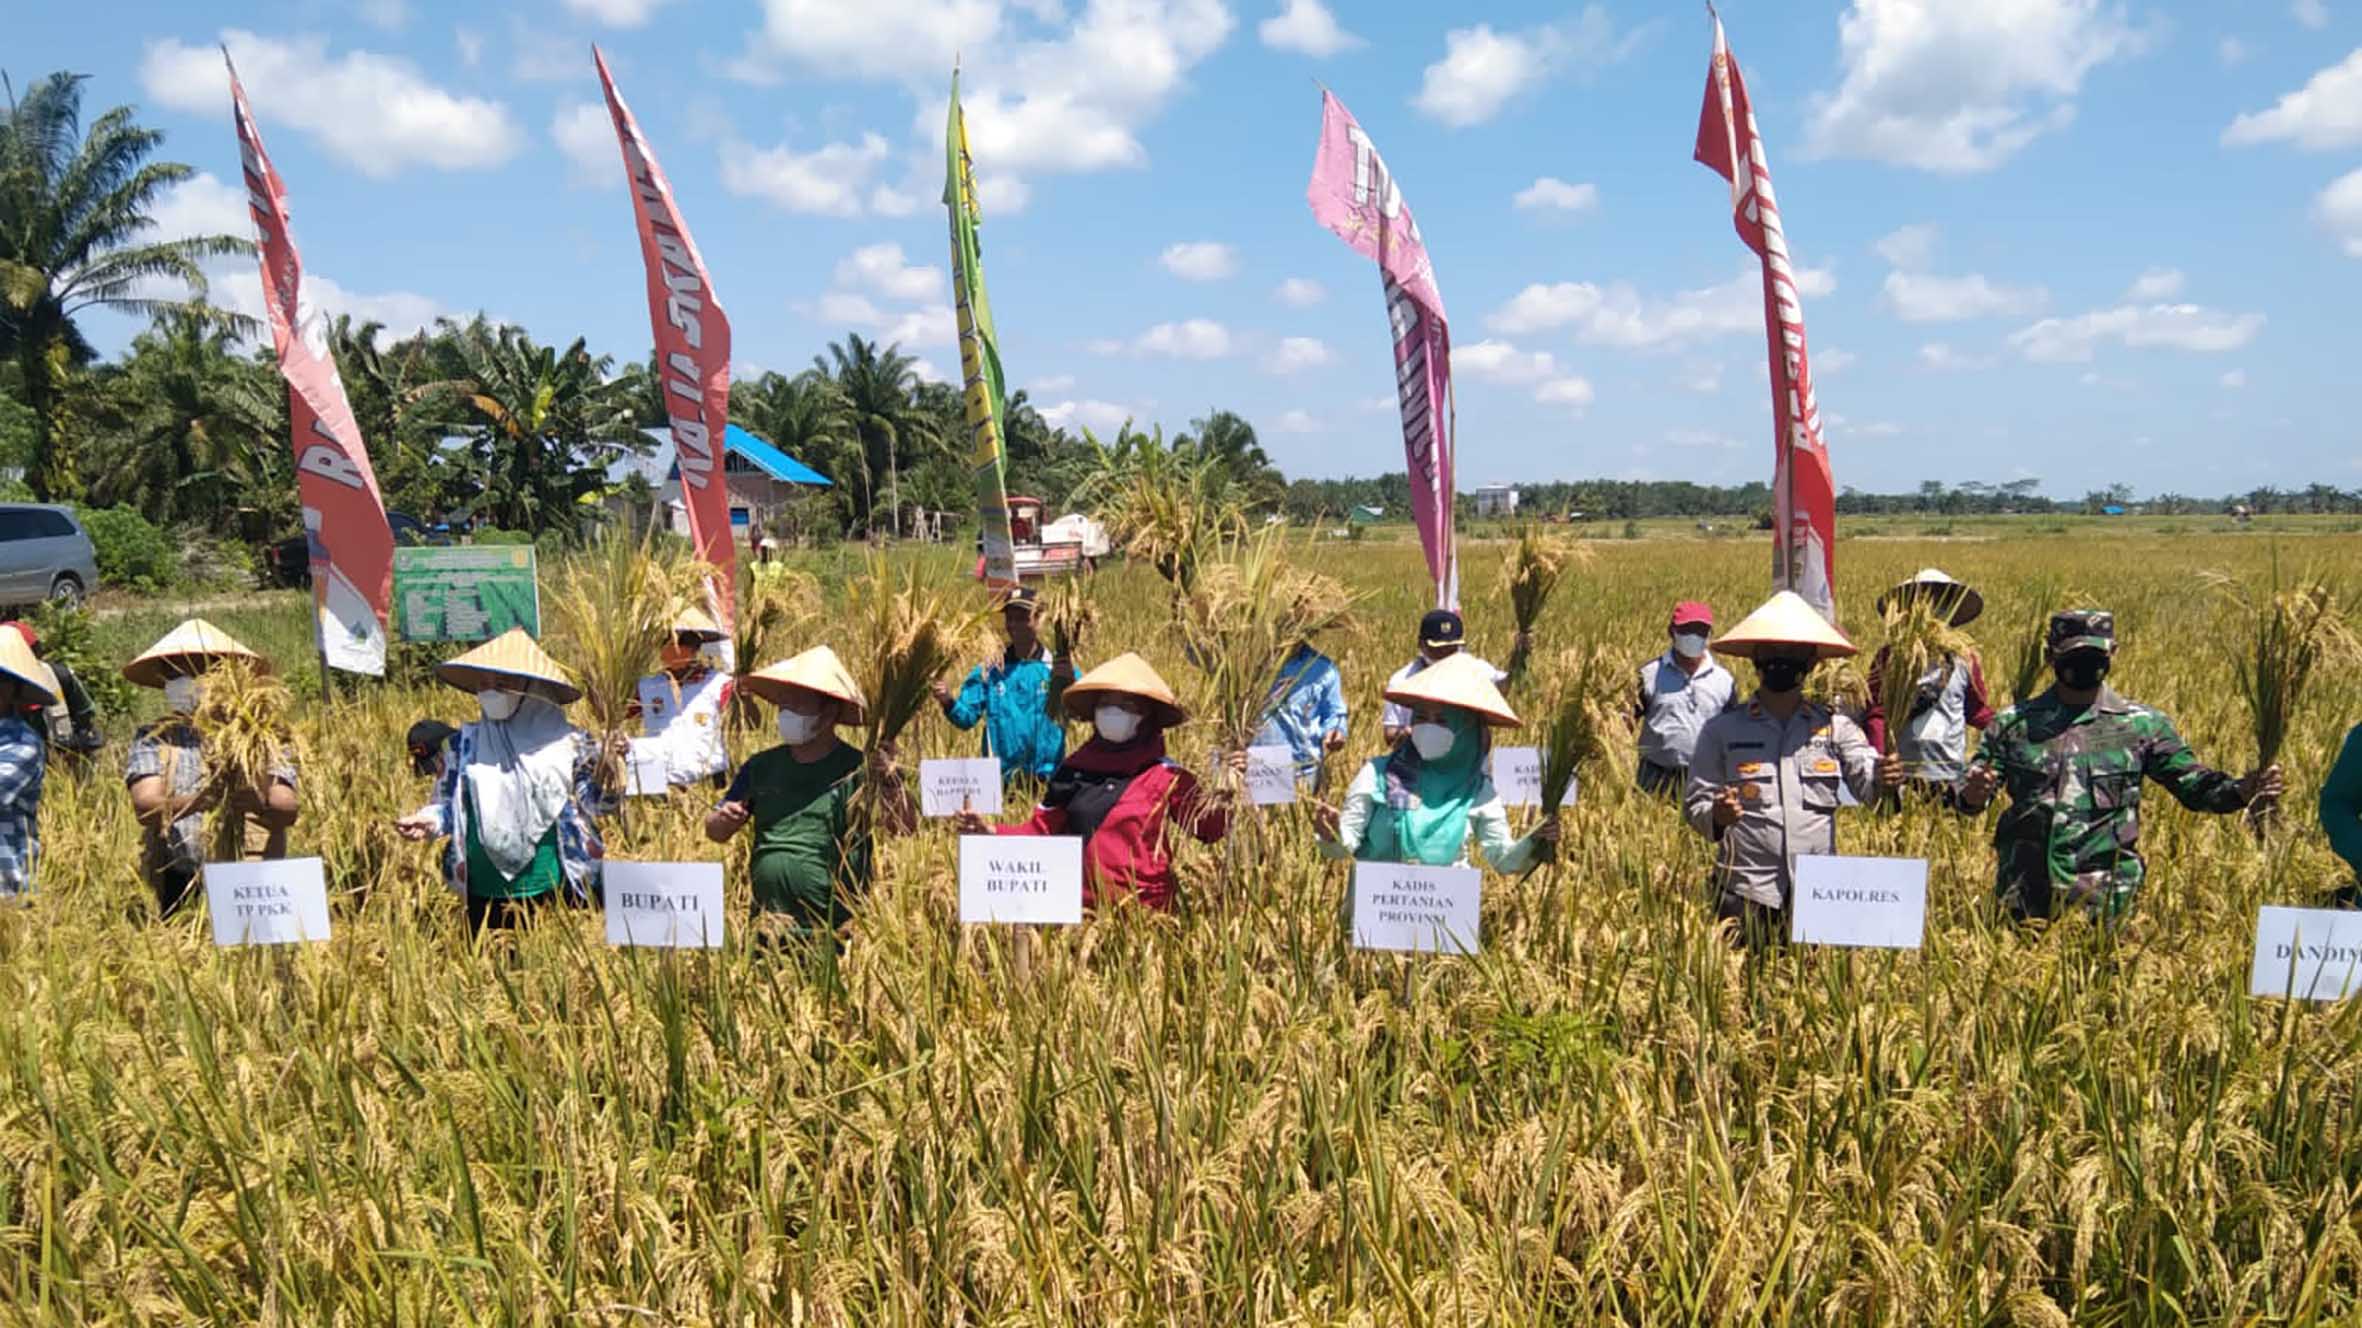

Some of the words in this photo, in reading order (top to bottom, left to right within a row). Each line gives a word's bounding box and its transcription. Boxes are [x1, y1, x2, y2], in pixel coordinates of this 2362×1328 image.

[988, 859, 1047, 873] WAKIL
[233, 885, 289, 900] KETUA
[986, 879, 1047, 893] BUPATI
[1392, 880, 1437, 892] KADIS
[621, 892, 698, 911] BUPATI
[1371, 893, 1453, 908] PERTANIAN
[1811, 887, 1901, 902] KAPOLRES
[233, 902, 254, 917] TP
[258, 902, 293, 917] PKK
